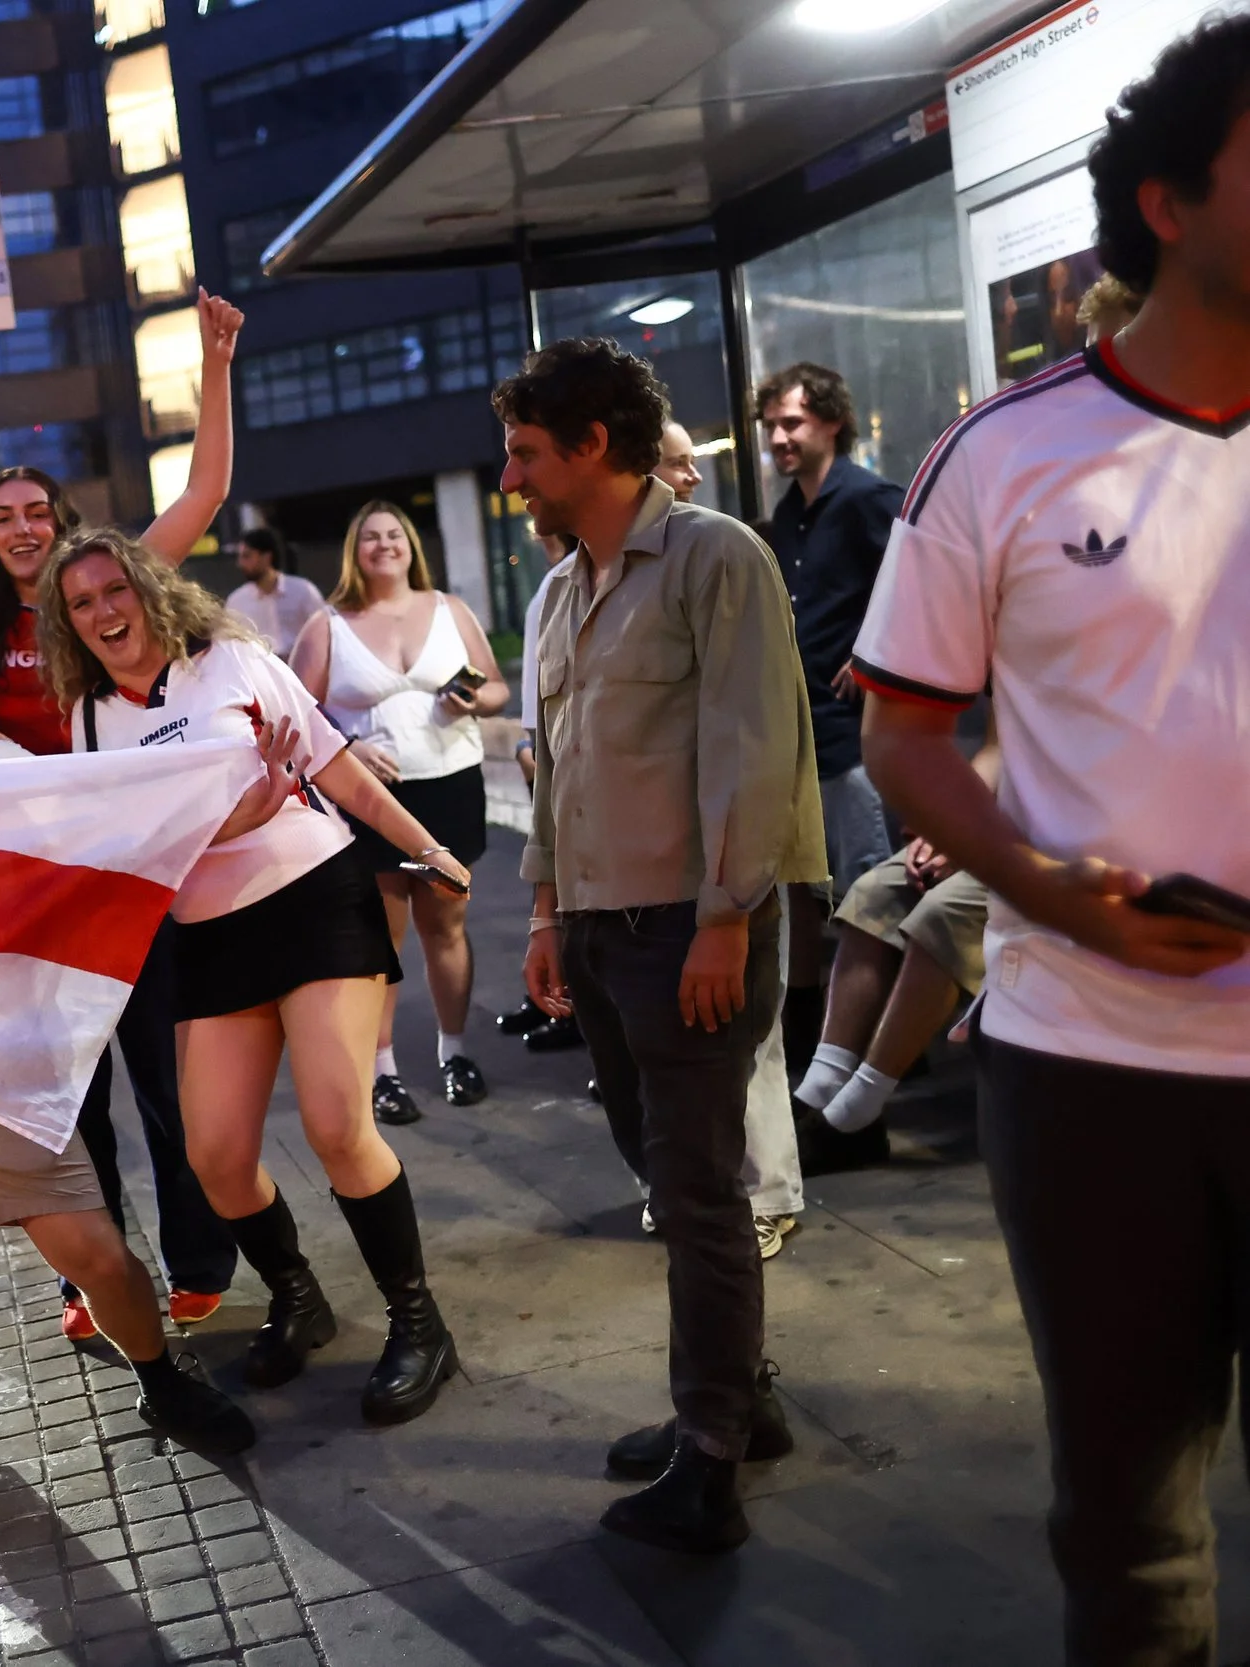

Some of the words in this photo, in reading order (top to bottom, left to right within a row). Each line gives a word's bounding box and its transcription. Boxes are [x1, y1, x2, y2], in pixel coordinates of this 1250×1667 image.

[963, 53, 1019, 91] Shoreditch
[1021, 37, 1046, 60] High
[1049, 17, 1082, 46] Street
[139, 717, 189, 747] UMBRO
